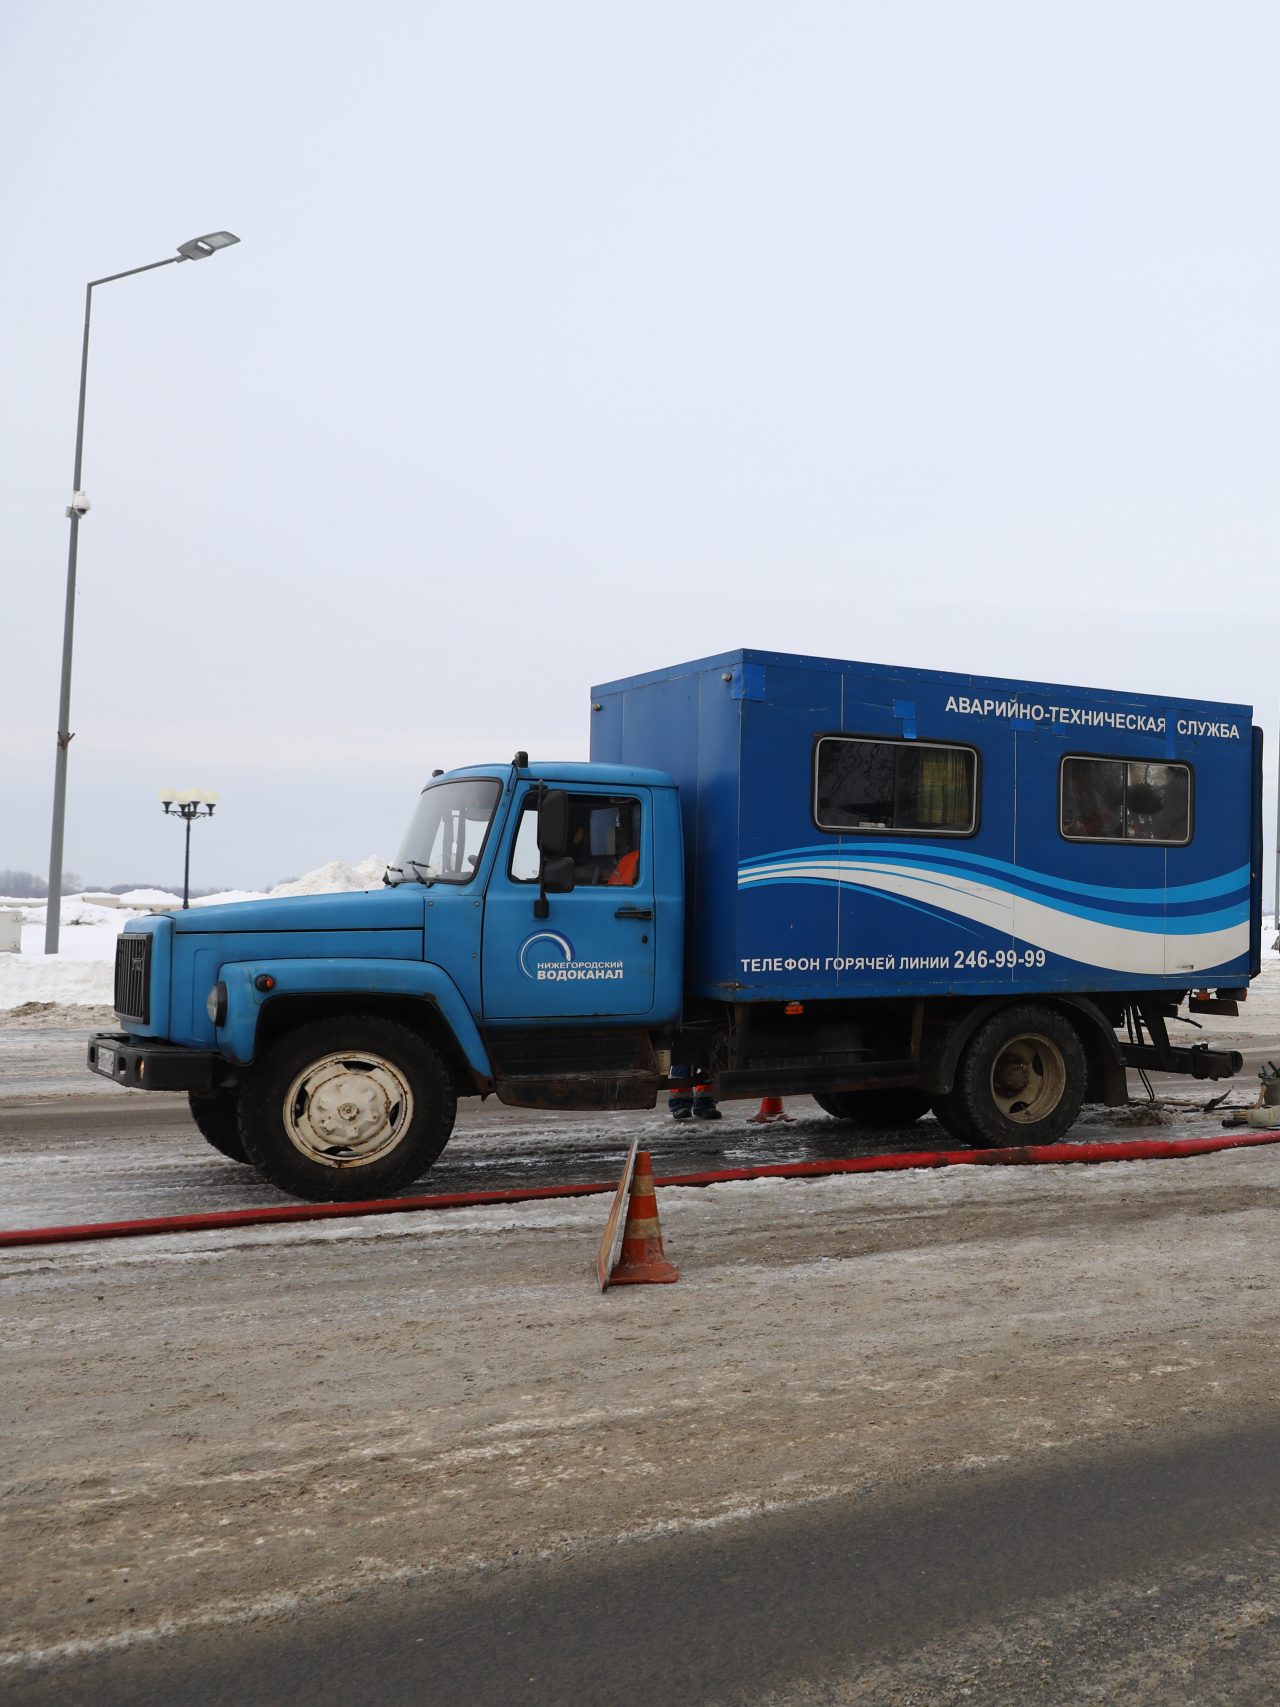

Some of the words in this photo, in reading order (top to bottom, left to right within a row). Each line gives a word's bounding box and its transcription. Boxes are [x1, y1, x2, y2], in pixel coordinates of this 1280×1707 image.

[945, 695, 1166, 733] АВАРИЙНО-ТЕХНИЧЕСКАЯ
[1176, 719, 1240, 739] СЛУЖБА
[537, 961, 623, 970] НИЖЕГОРОДСКИЙ
[741, 957, 820, 972] ТЕЛЕФОН
[825, 954, 895, 971] ГОРЯЧЕЙ
[899, 956, 950, 970] ЛИНИИ
[953, 949, 1047, 969] 246-99-99
[537, 970, 623, 981] ВОДОКАНАЛ
